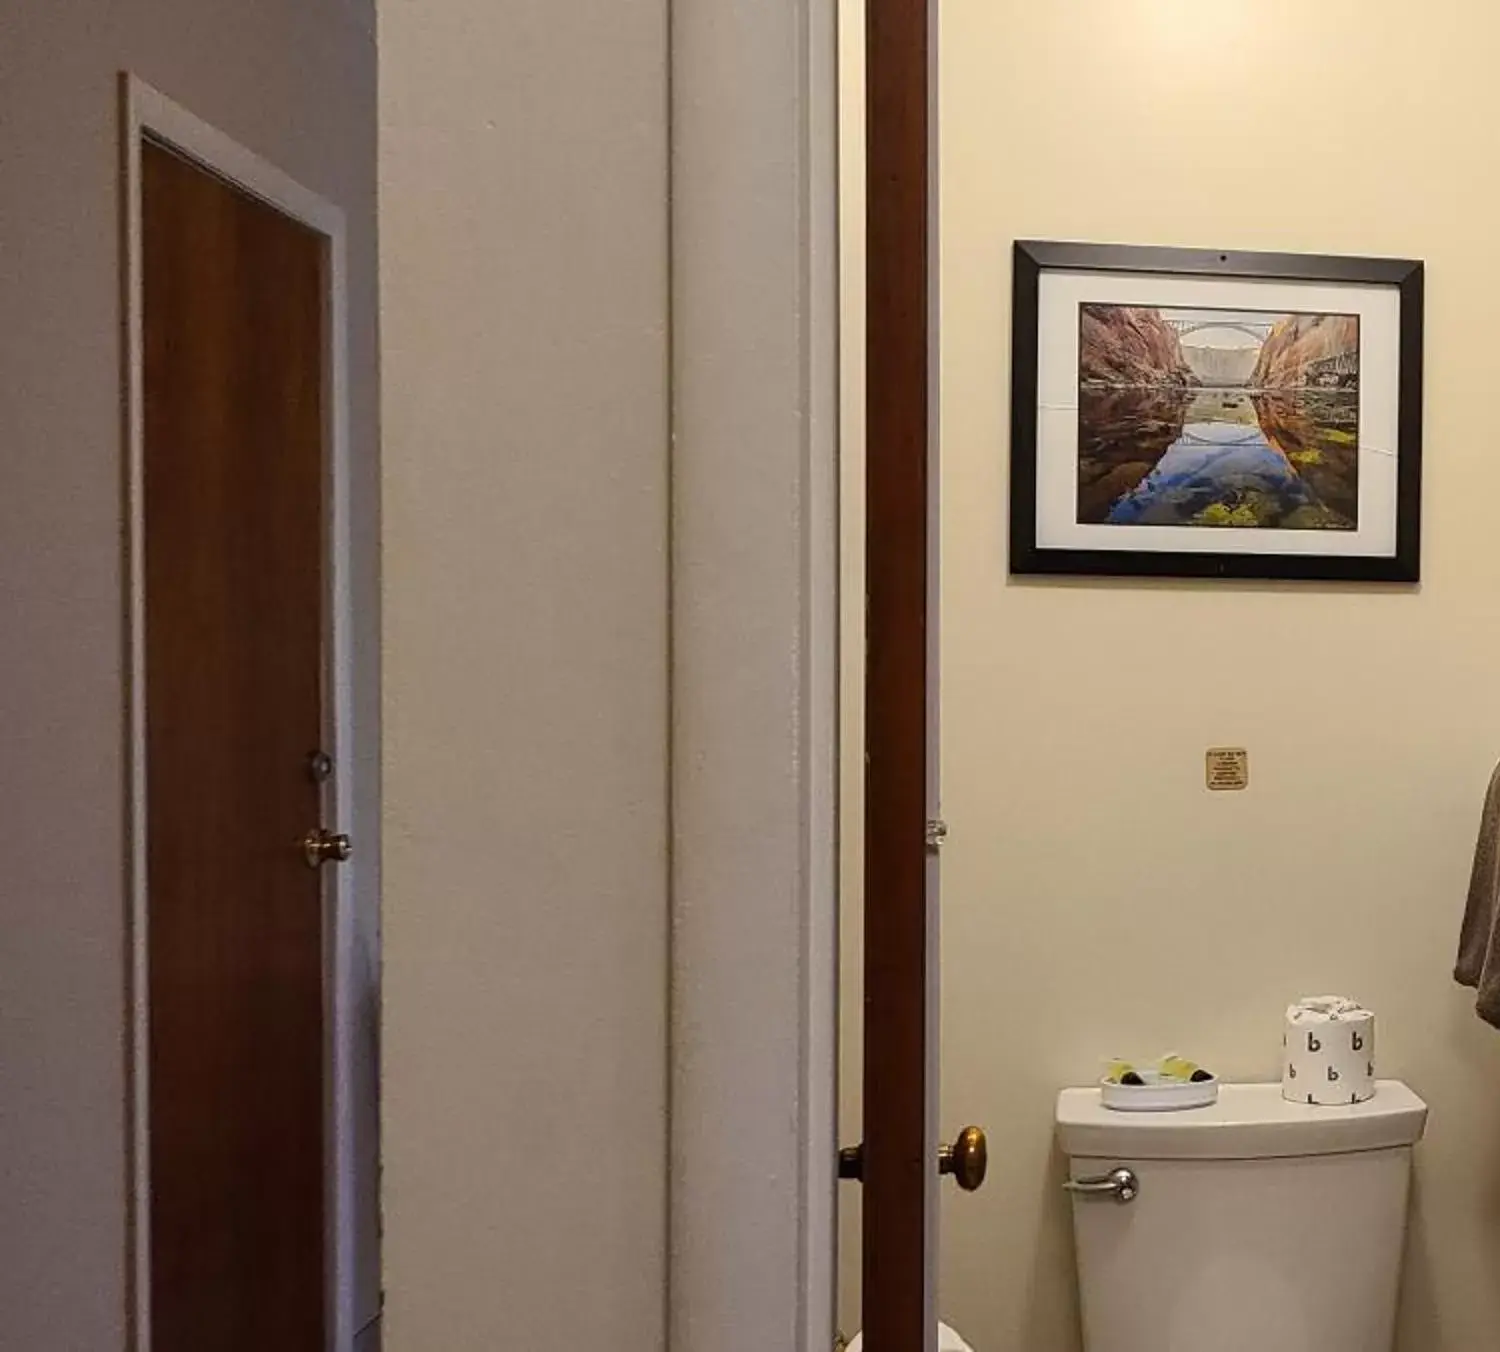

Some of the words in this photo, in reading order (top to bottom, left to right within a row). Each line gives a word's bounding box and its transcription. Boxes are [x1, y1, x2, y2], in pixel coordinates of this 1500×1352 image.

[1308, 1032, 1321, 1052] b
[1352, 1032, 1362, 1050] b
[1289, 1063, 1296, 1079] b
[1328, 1066, 1339, 1081] b
